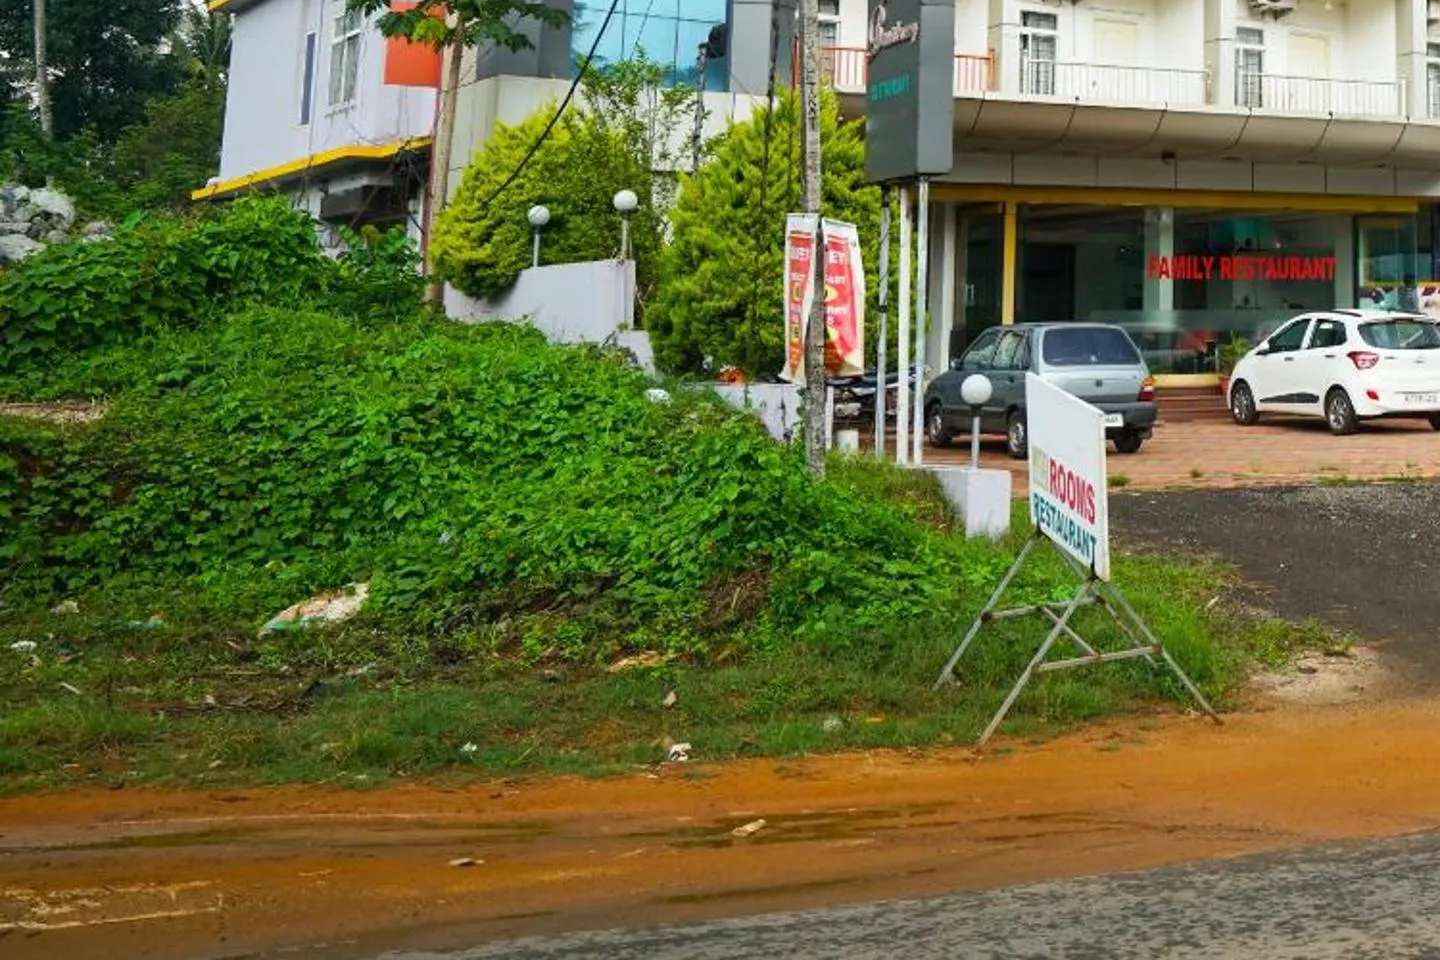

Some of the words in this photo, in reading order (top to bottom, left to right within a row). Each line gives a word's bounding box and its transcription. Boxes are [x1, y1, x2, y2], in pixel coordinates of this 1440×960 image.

[1147, 255, 1214, 281] FAMILY
[1219, 255, 1336, 281] RESTAURANT
[1033, 491, 1097, 558] RESTAURANT
[1049, 458, 1096, 525] ROOMS
